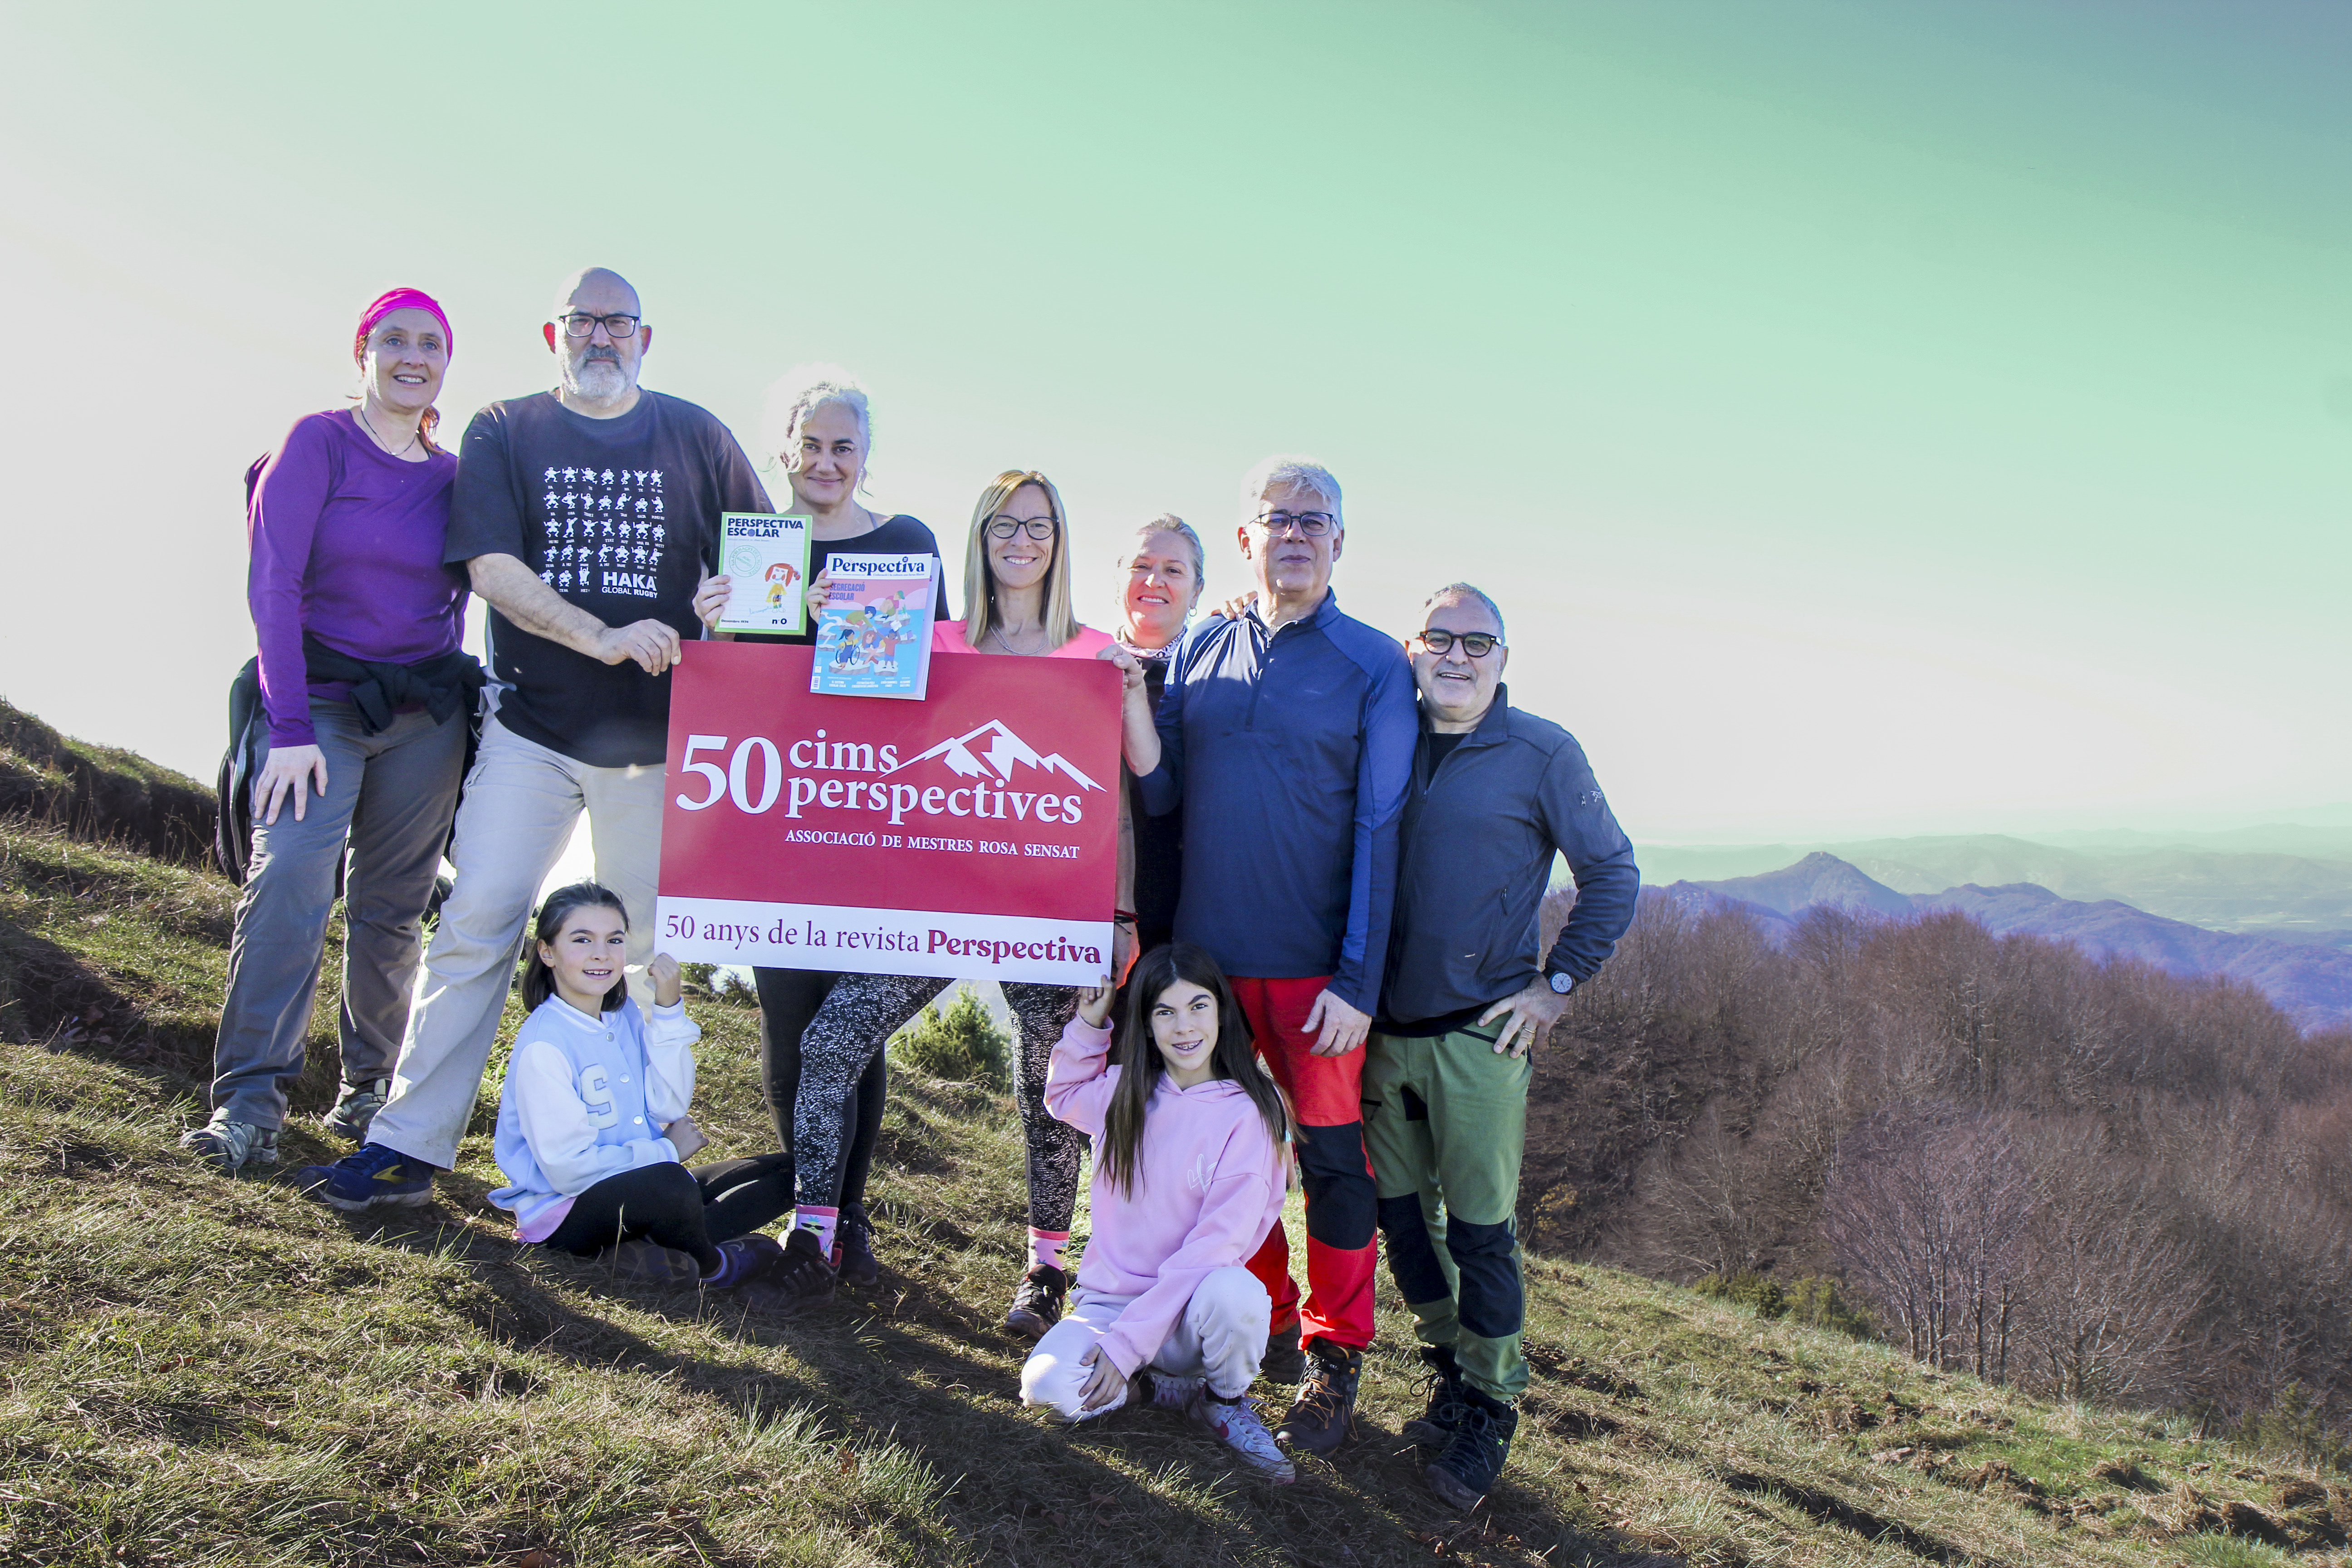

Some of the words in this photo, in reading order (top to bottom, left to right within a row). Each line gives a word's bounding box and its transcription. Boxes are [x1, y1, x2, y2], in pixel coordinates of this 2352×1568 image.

[727, 518, 804, 529] PERSPECTIVA
[727, 527, 780, 538] ESCOLAR
[832, 556, 925, 576] Perspectiva
[603, 571, 657, 591] HAKA
[830, 582, 865, 592] SEGREGACIÓ
[602, 586, 632, 595] GLOBAL
[633, 588, 658, 598] RUGBY
[828, 592, 854, 600] ESCOLAR
[789, 729, 898, 774] cims
[676, 734, 782, 814] 50
[784, 777, 1083, 826] perspectives
[785, 829, 876, 847] ASSOCIACIÓ
[881, 834, 902, 848] DE
[907, 836, 973, 853] MESTRES
[979, 840, 1019, 856] ROSA
[1024, 843, 1080, 859] SENSAT
[666, 915, 695, 939] 50
[703, 923, 760, 951] anys
[768, 918, 798, 945] de
[805, 920, 827, 946] la
[835, 926, 920, 952] revista
[927, 929, 1102, 965] Perspectiva
[580, 1063, 618, 1130] S
